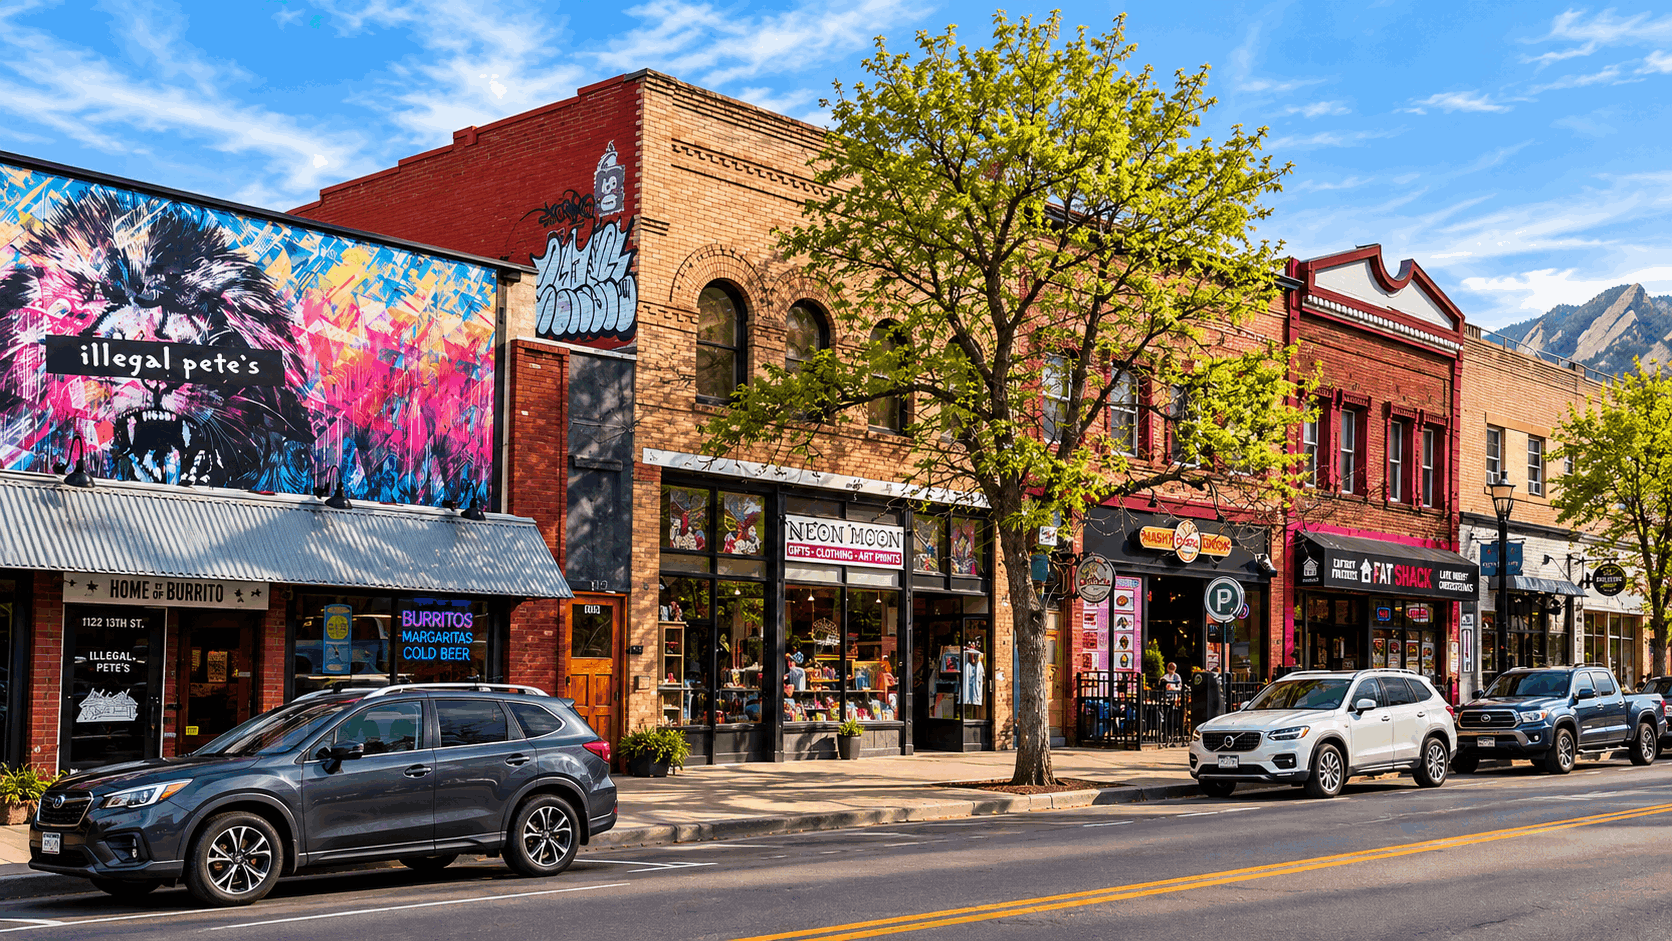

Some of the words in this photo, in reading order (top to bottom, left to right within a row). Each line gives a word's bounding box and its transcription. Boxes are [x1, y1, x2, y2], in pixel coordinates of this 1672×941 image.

[81, 342, 171, 377] illegal
[182, 353, 260, 379] pete's
[788, 521, 844, 542] NEON
[849, 525, 902, 548] MOON
[788, 545, 811, 556] GIFTS
[816, 548, 853, 560] CLOTHING
[858, 551, 874, 561] ART
[875, 552, 901, 564] PRINTS
[1373, 561, 1394, 585] FAT
[1394, 564, 1432, 589] SHACK
[110, 579, 149, 599] HOME
[166, 581, 224, 603] BURRITO
[1216, 588, 1233, 612] P
[82, 617, 103, 627] 1122
[106, 618, 127, 628] 13TH
[130, 618, 145, 629] ST.
[402, 610, 473, 629] BURRITOS
[402, 630, 473, 644] MARGARITAS
[403, 646, 437, 660] COLD
[440, 647, 471, 661] BEER
[96, 663, 131, 673] PETE'S
